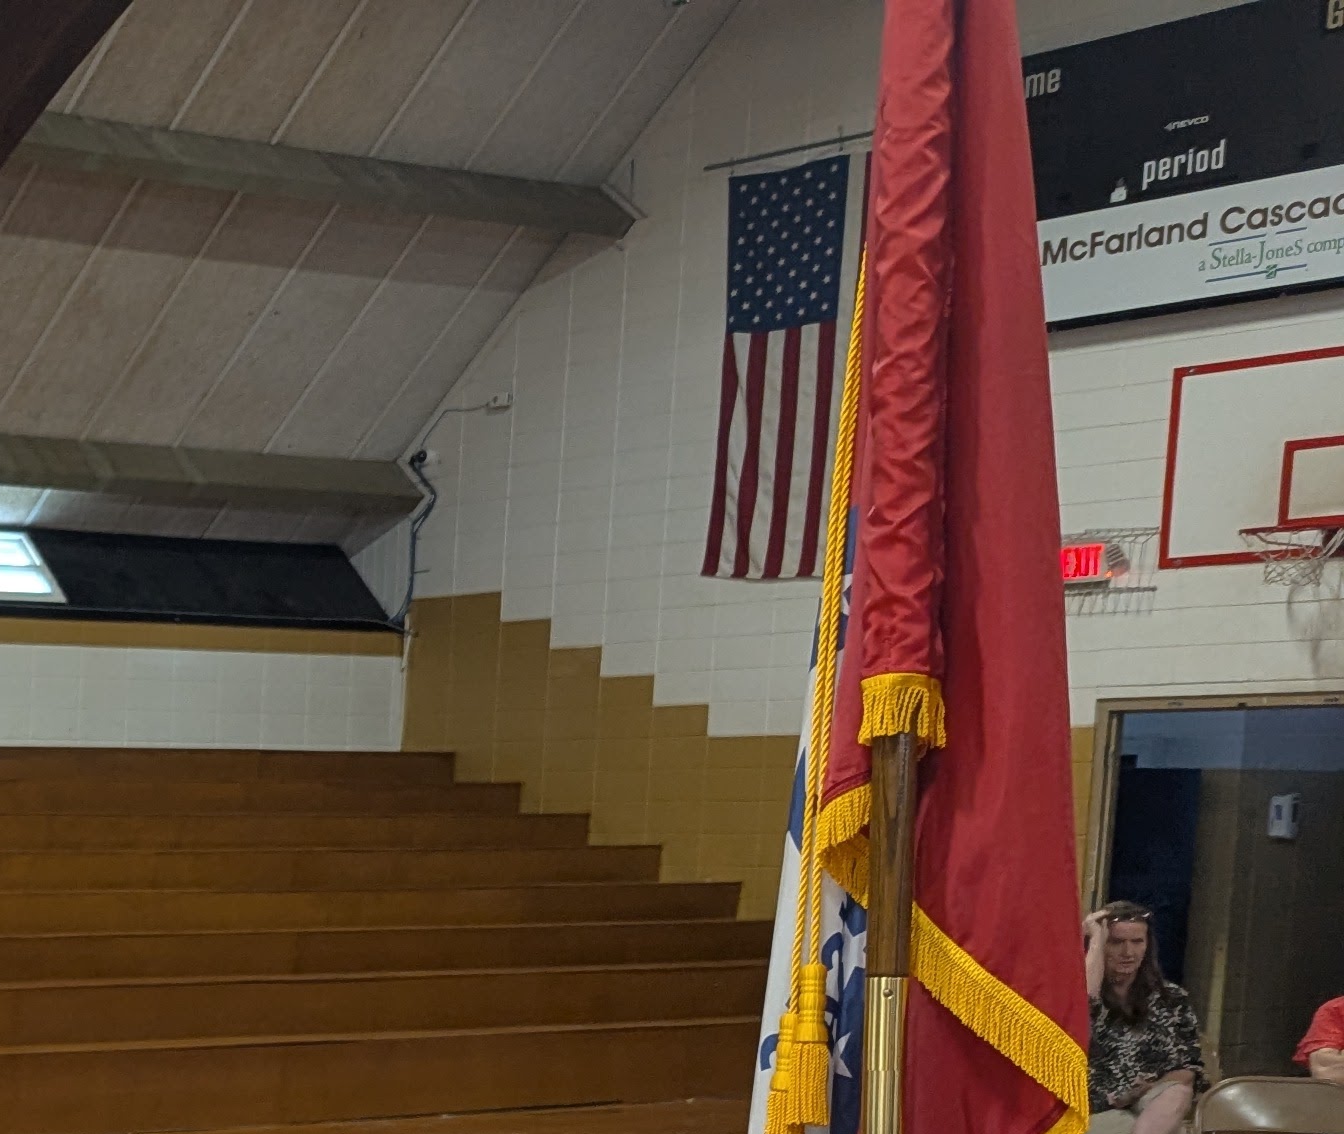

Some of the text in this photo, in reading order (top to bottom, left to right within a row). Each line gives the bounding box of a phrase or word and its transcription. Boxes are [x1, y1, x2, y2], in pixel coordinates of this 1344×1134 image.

[1025, 69, 1062, 99] me
[1141, 138, 1226, 191] period
[1042, 211, 1209, 266] McFarland
[1198, 260, 1206, 272] a
